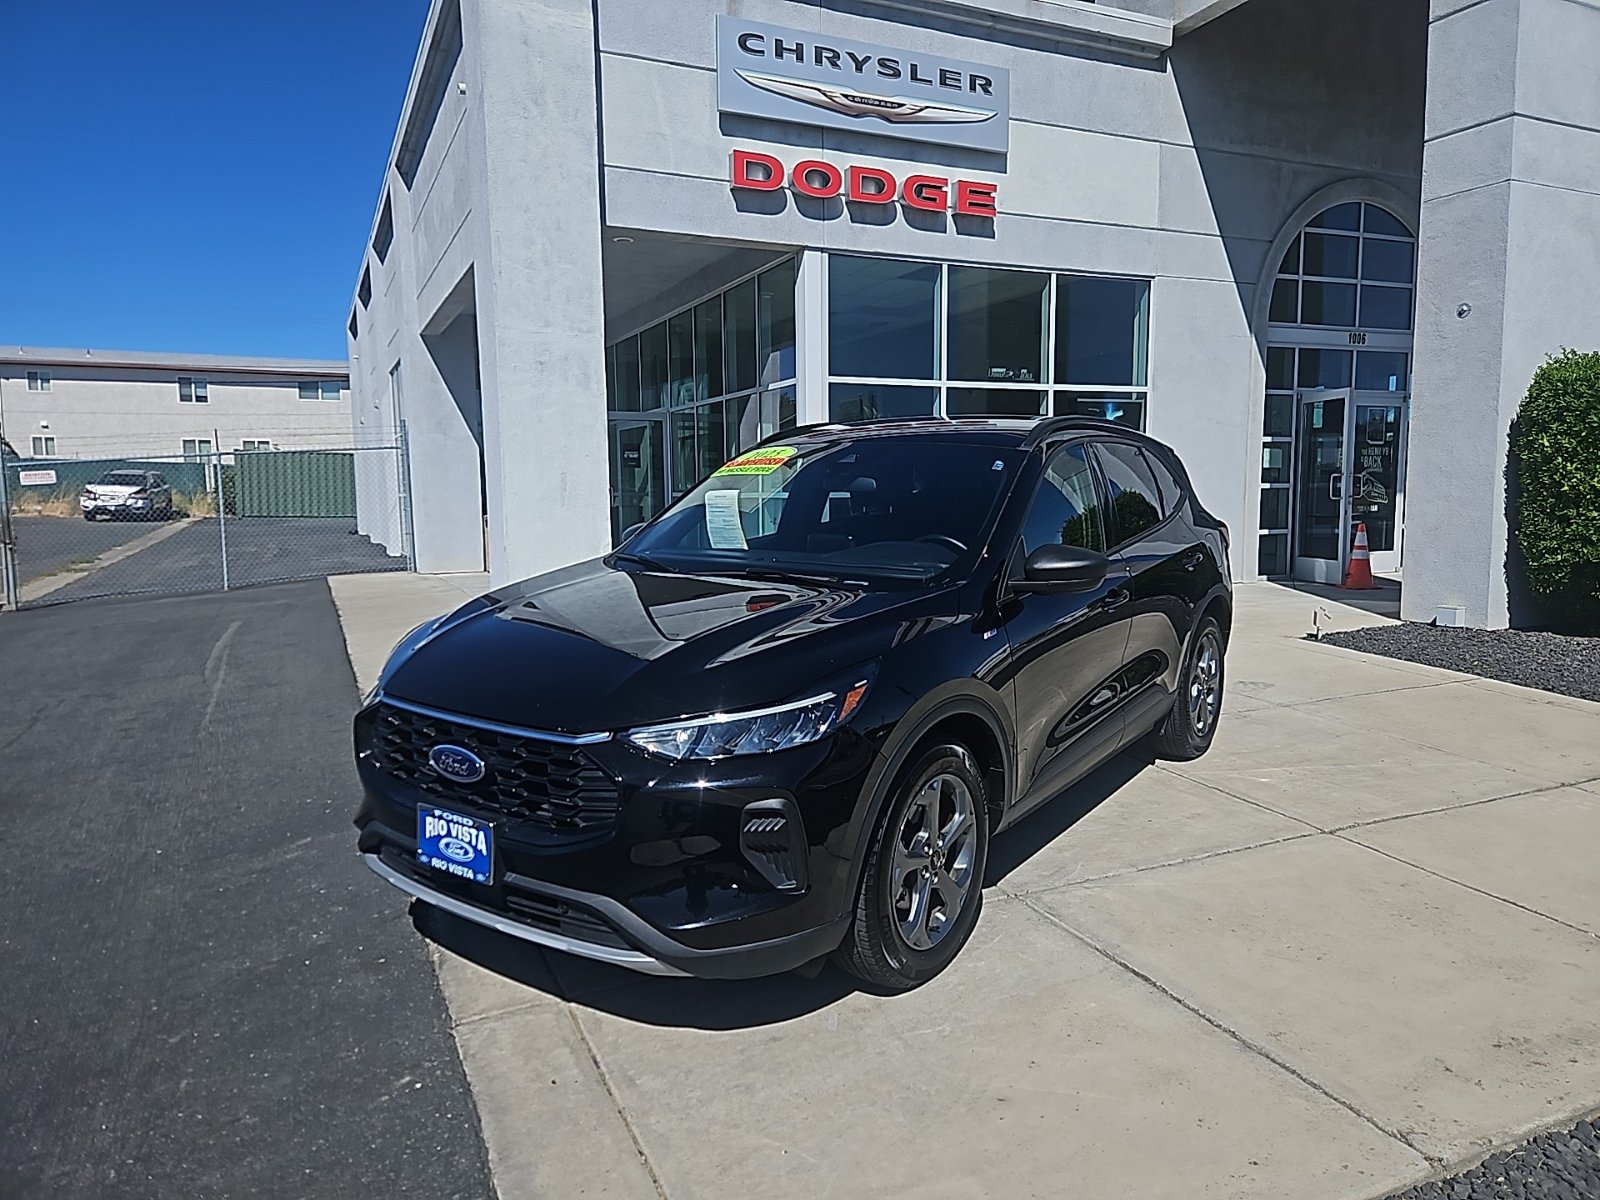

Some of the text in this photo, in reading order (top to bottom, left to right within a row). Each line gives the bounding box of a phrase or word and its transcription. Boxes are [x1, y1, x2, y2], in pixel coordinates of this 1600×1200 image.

[737, 32, 994, 96] CHRYSLER
[731, 149, 998, 217] DODGE
[1348, 332, 1367, 345] 1006
[1364, 455, 1382, 468] BACK
[439, 751, 470, 776] Ford
[433, 810, 474, 827] FORD
[425, 816, 488, 857] RIO VISTA
[431, 856, 448, 871] RIO
[448, 861, 475, 880] VISTA
